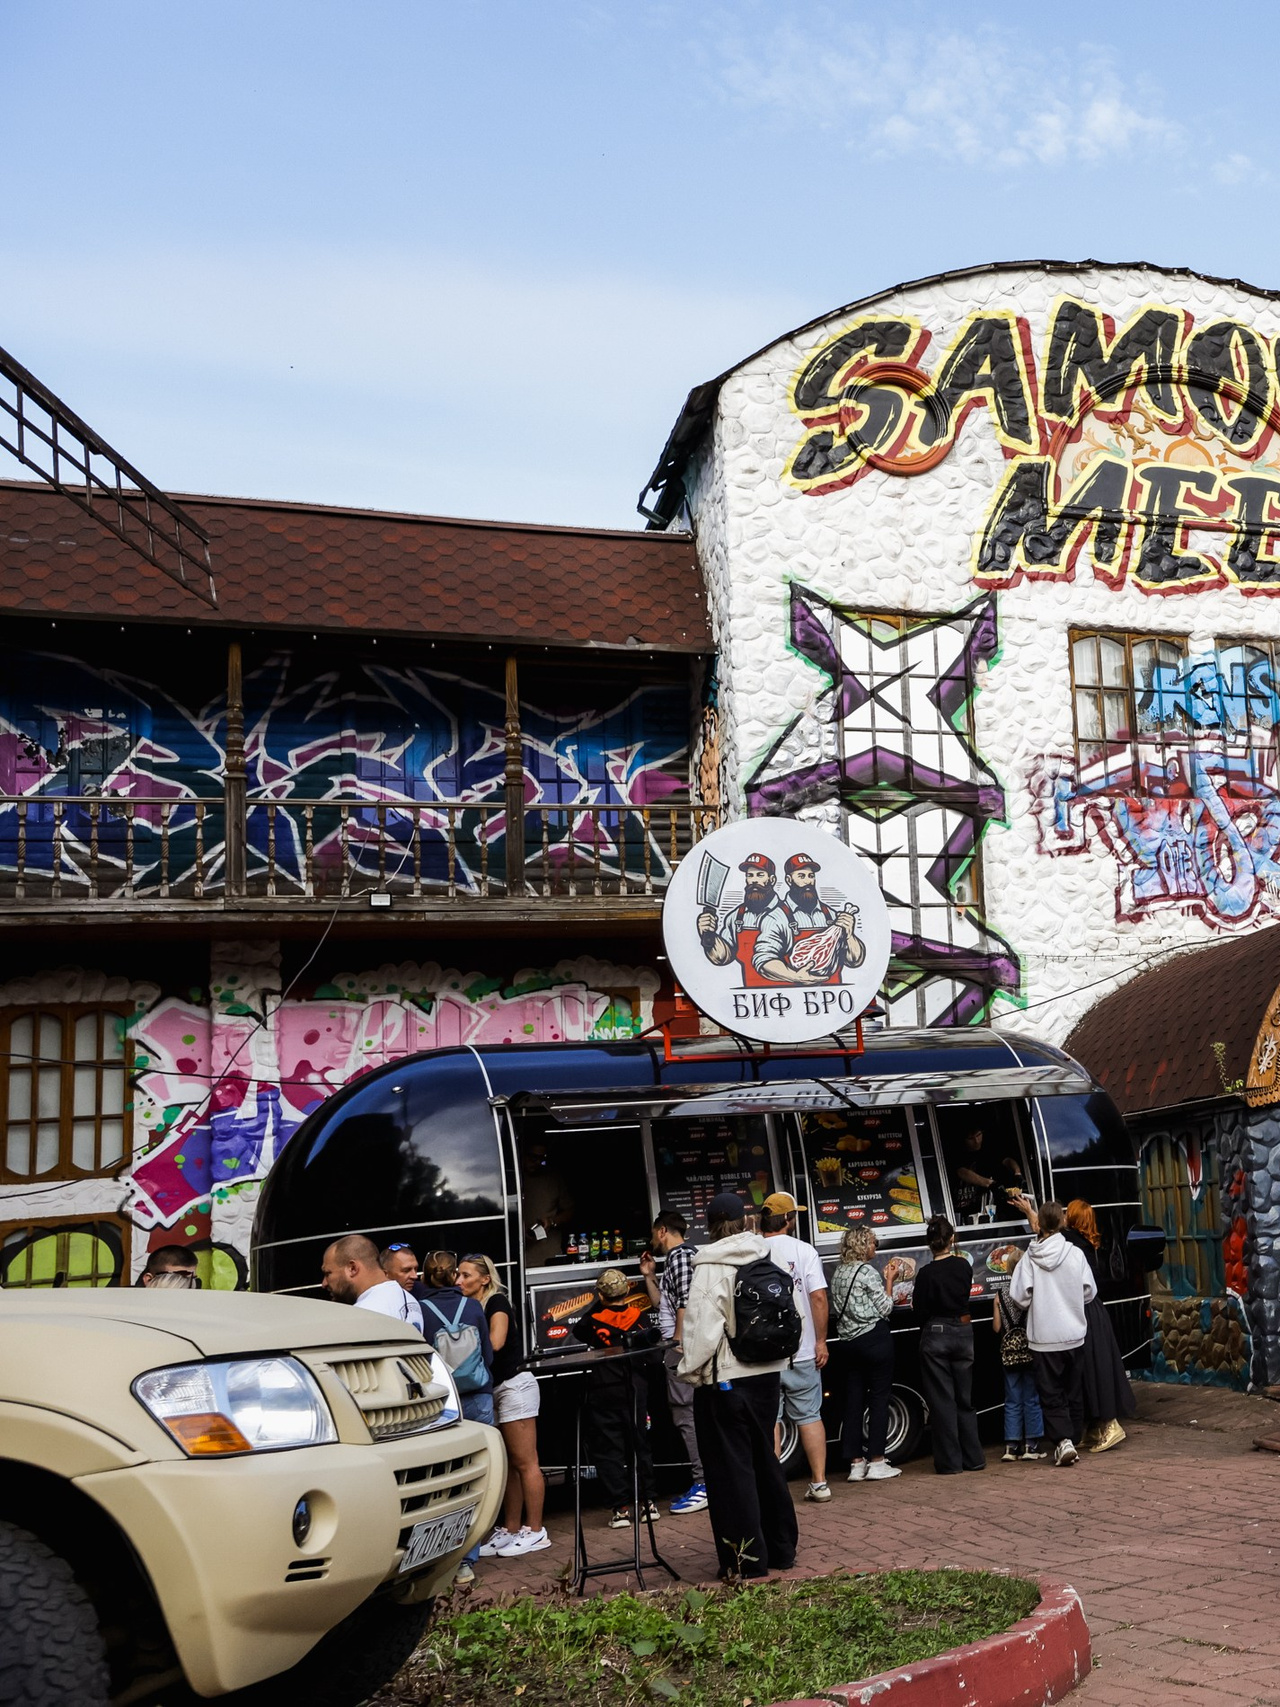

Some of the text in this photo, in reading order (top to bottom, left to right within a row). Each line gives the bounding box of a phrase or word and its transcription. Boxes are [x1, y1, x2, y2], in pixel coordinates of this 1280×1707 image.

[732, 989, 854, 1019] БИФ БРО
[847, 1160, 875, 1168] КАРТОШКА
[741, 1171, 751, 1179] TEA
[857, 1193, 882, 1201] КУКУРУЗА
